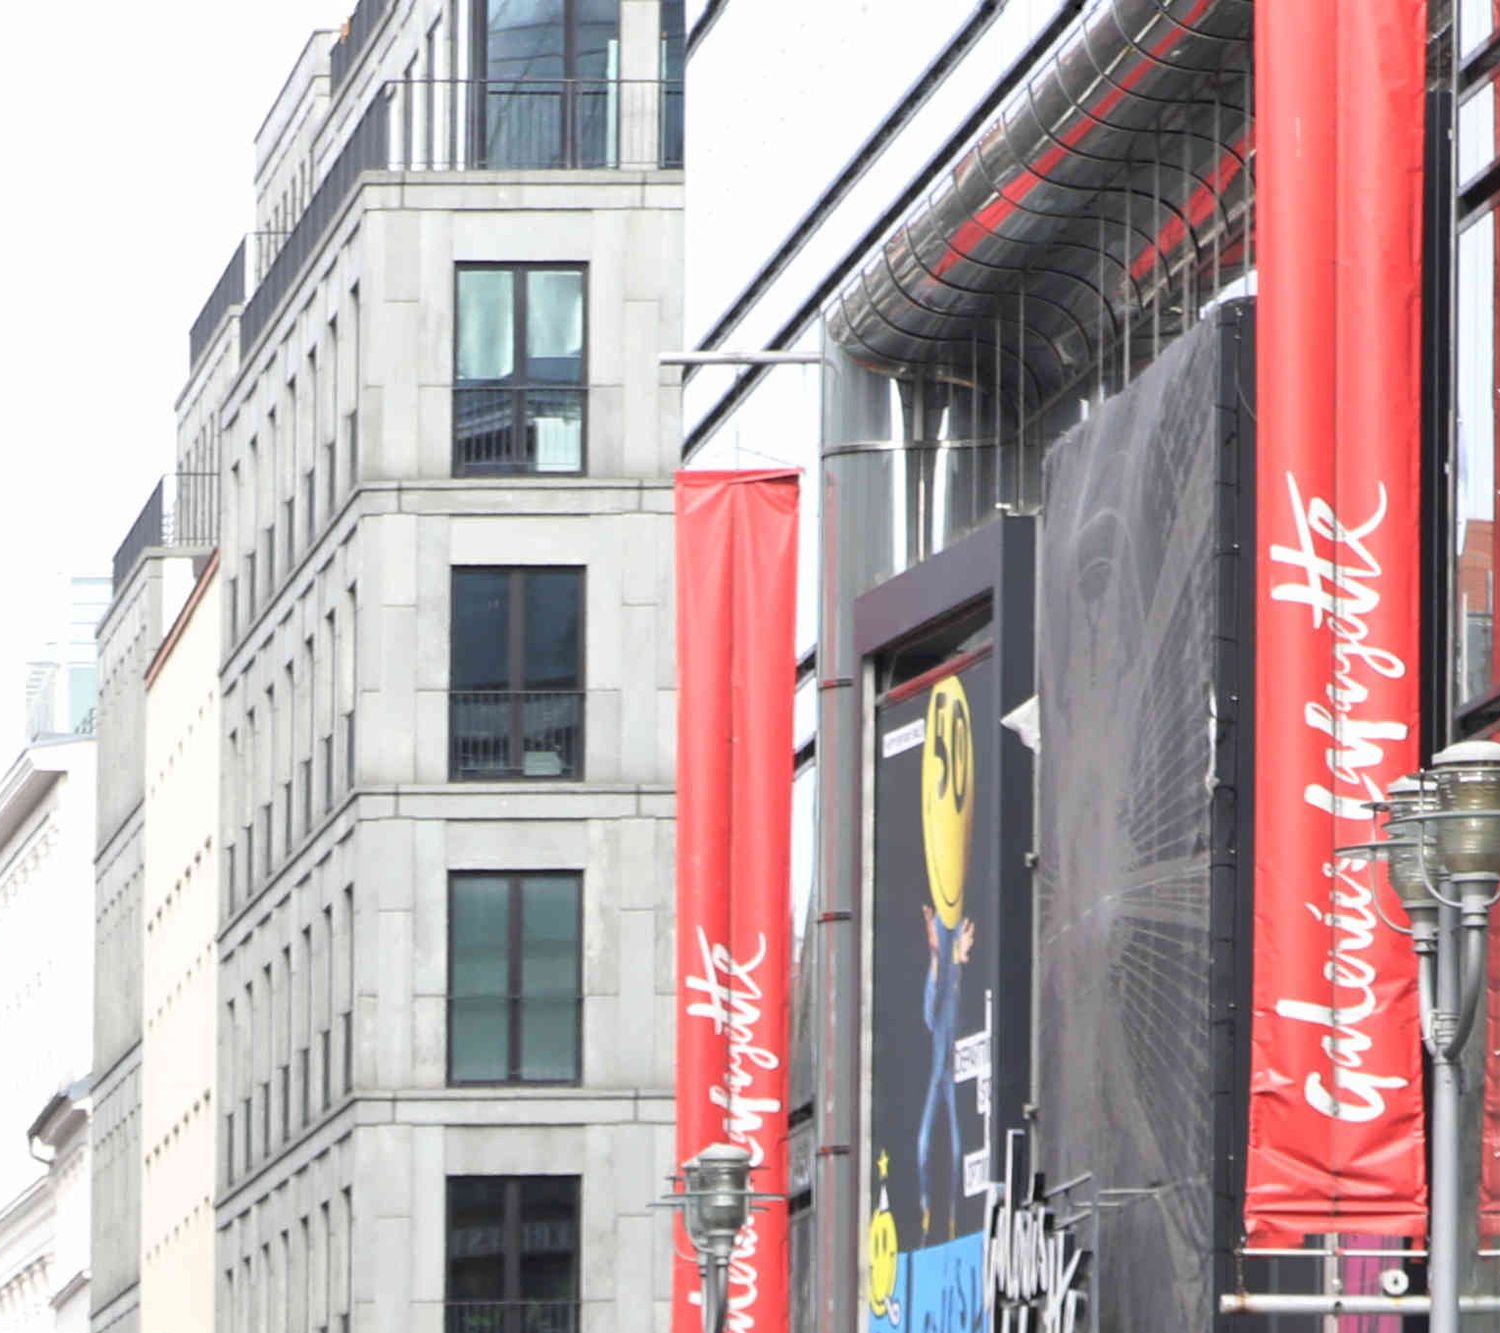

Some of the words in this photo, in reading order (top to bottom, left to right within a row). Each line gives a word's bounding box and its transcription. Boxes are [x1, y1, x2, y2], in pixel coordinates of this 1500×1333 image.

[934, 692, 969, 815] 50
[1270, 470, 1407, 818] Lafayette
[1277, 855, 1407, 1122] Galeries
